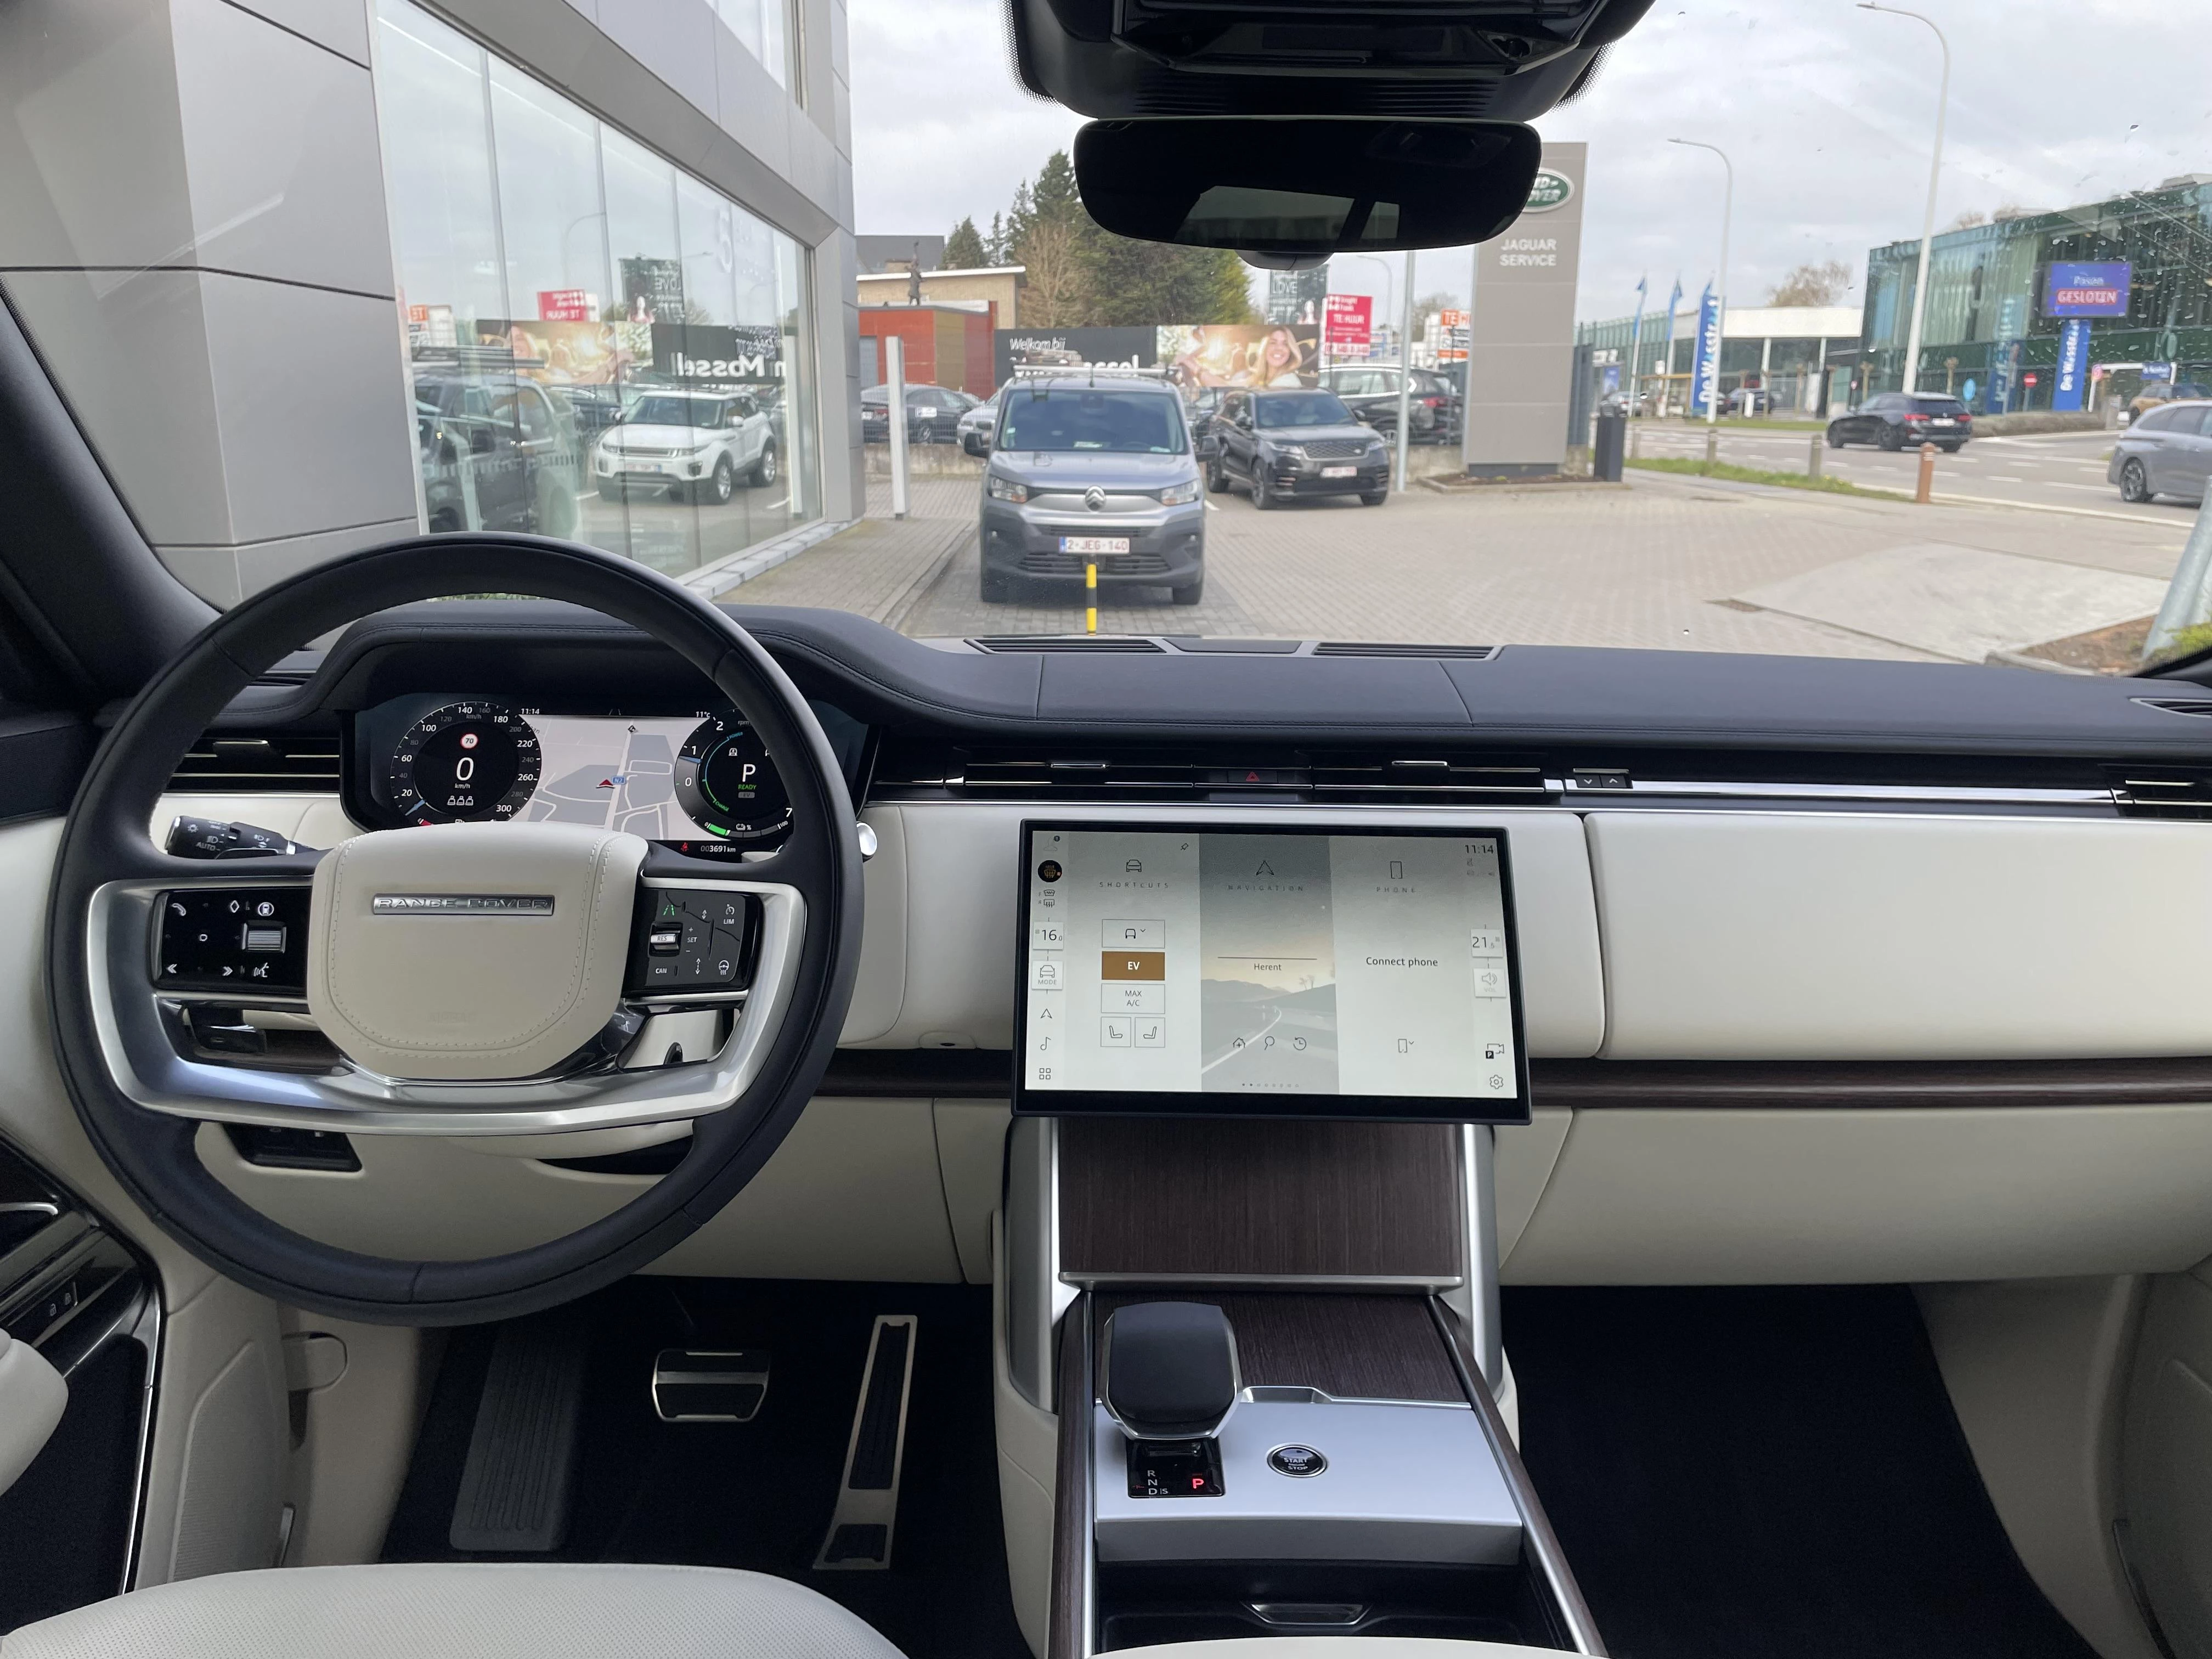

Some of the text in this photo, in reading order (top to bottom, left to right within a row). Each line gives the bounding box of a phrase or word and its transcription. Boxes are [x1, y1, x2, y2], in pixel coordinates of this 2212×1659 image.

[1501, 239, 1556, 250] JAGUAR
[1499, 254, 1556, 266] SERVICE
[2058, 290, 2117, 303] GESLOTEN
[716, 721, 724, 731] 2
[691, 746, 697, 754] 1
[456, 757, 474, 781] 0
[742, 764, 756, 782] P
[685, 777, 692, 787] 0
[786, 808, 793, 817] 7
[196, 842, 216, 851] AUTO
[1465, 844, 1494, 854] 11:14
[379, 899, 549, 909] RANGE ROVER
[1127, 962, 1140, 970] EV
[1366, 957, 1438, 968] Connect phone
[1192, 1479, 1204, 1489] P
